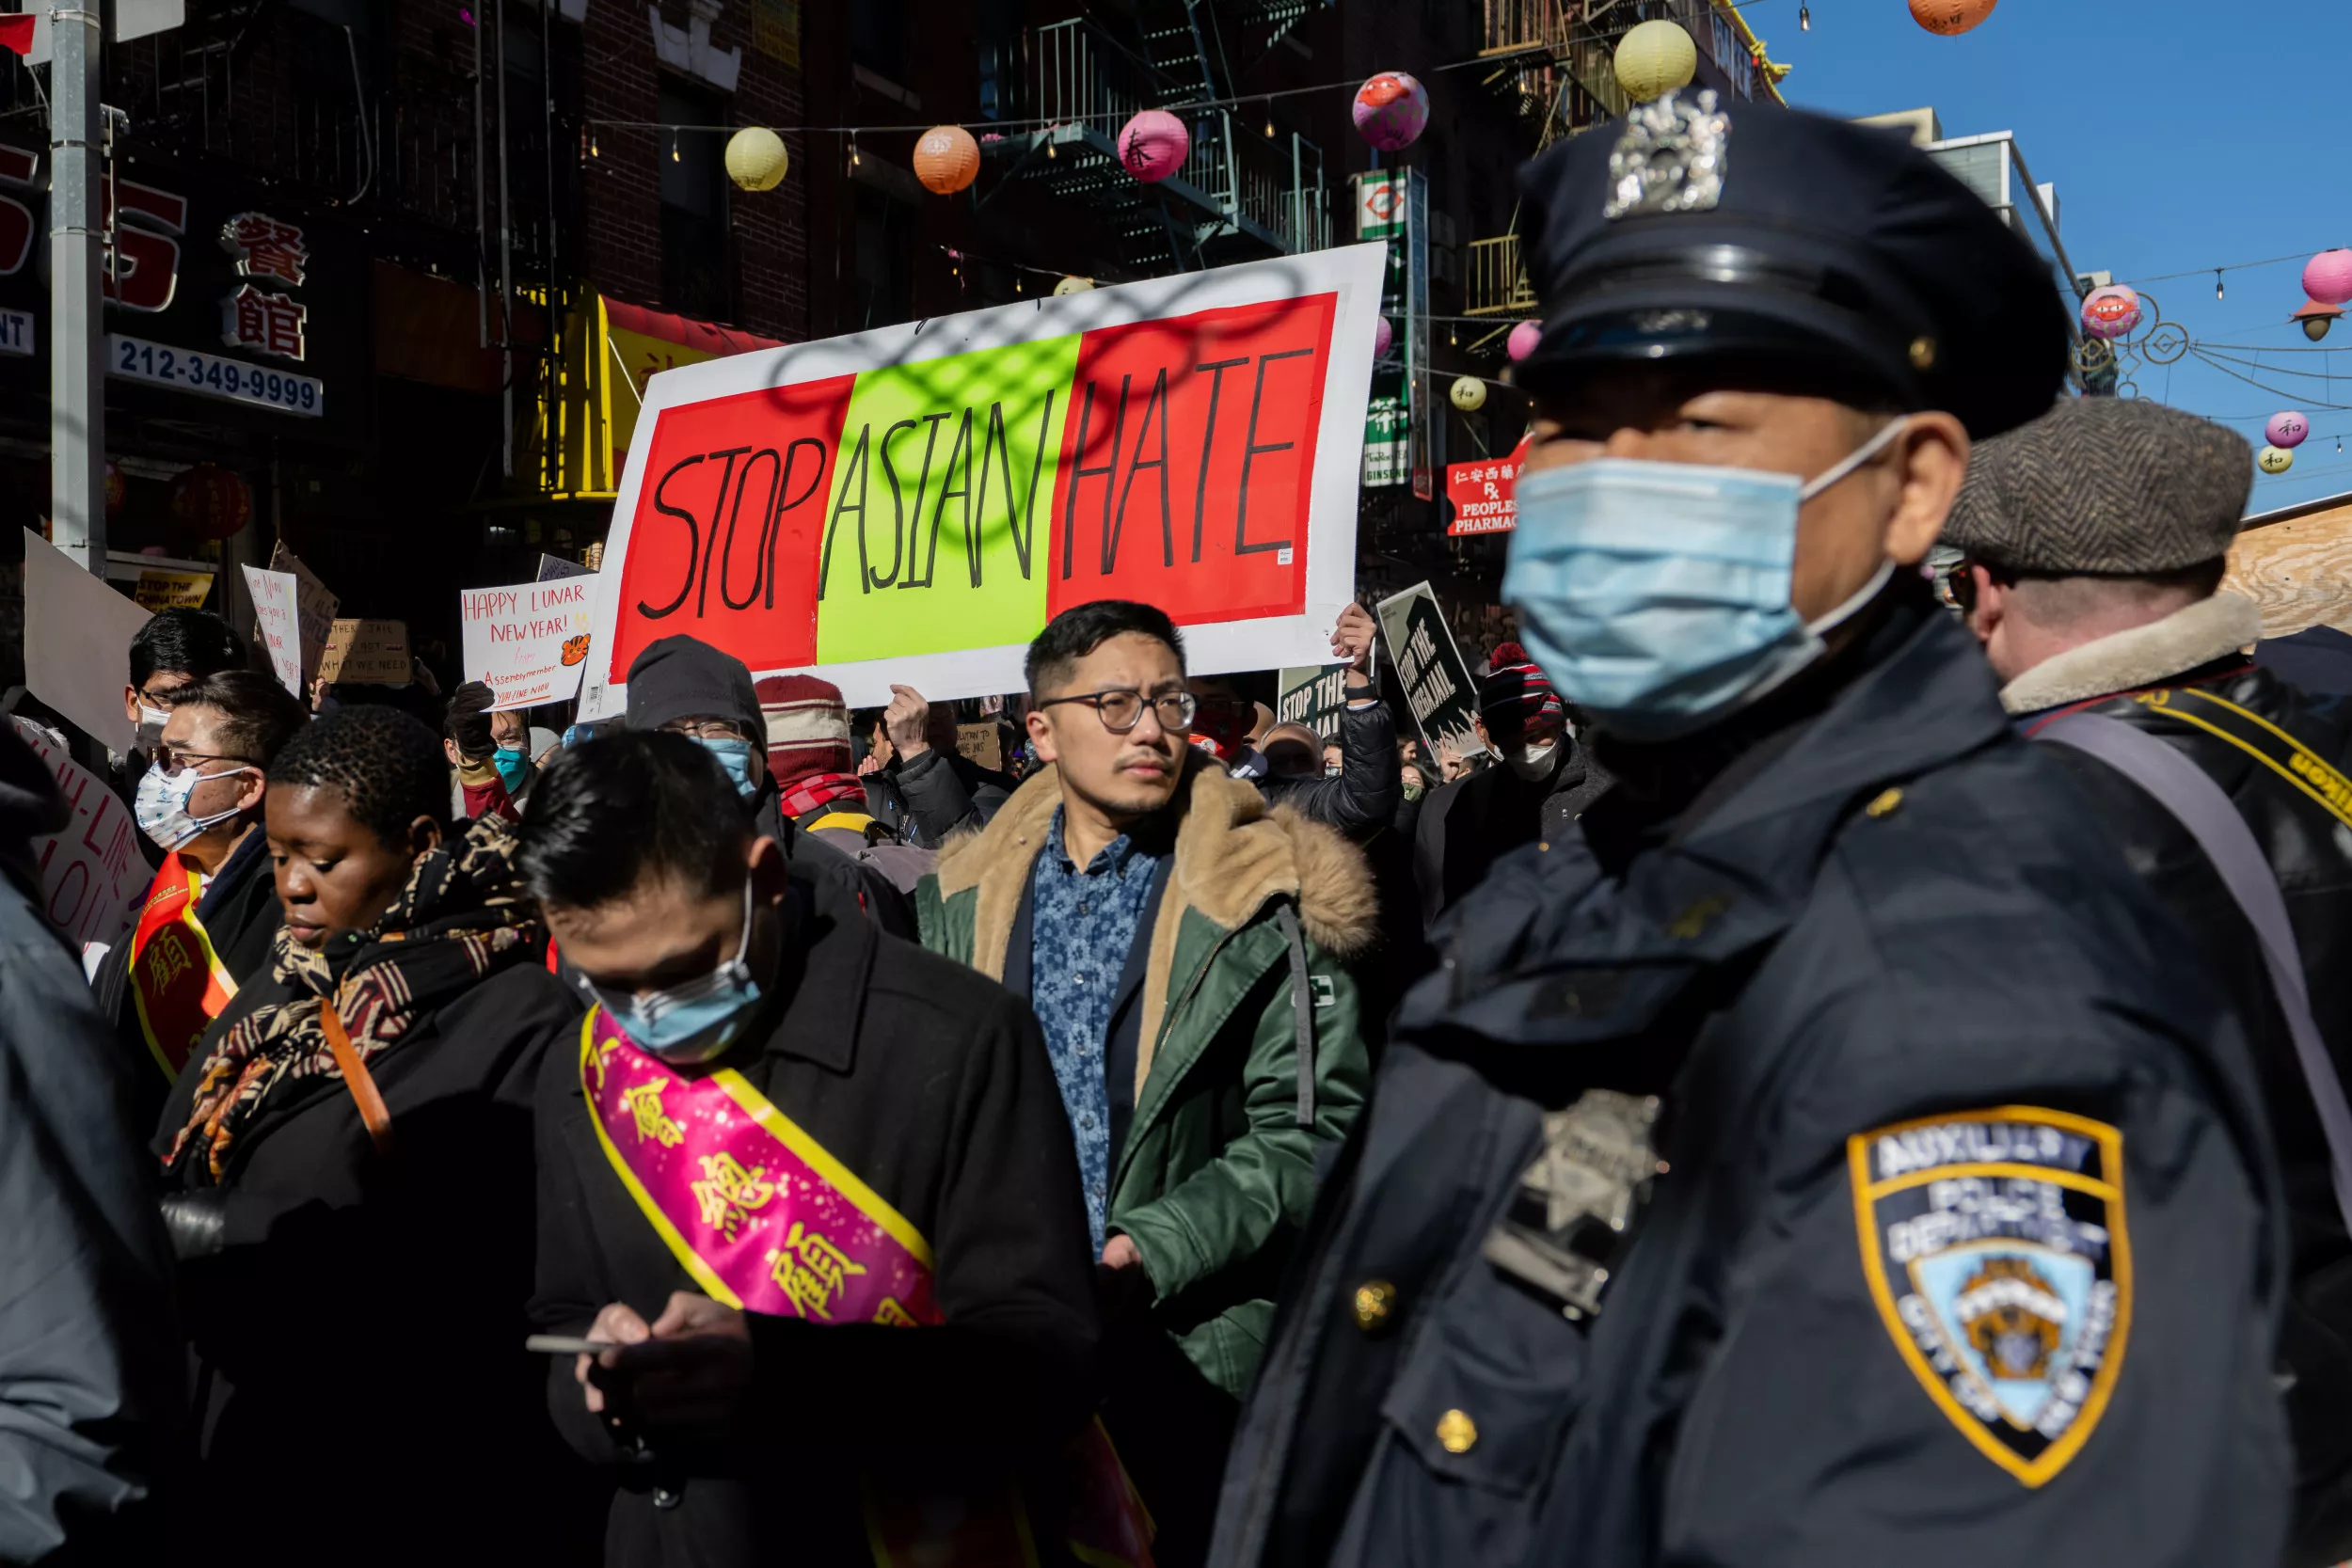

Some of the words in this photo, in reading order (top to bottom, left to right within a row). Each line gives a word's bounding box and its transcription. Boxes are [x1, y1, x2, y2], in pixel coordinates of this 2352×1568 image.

[235, 212, 309, 361] 餐館
[120, 341, 315, 409] 212-349-9999
[2278, 420, 2302, 437] 和
[2265, 452, 2283, 467] 和
[637, 437, 826, 619] STOP
[818, 388, 1056, 602] ASIAN
[1062, 348, 1313, 580] HATE
[138, 578, 169, 592] STOP
[171, 581, 193, 593] THE
[135, 593, 202, 605] CHINATOWN
[463, 592, 517, 621] HAPPY
[532, 584, 585, 611] LUNAR
[332, 624, 356, 634] THER
[491, 624, 527, 642] NEW
[530, 614, 567, 640] YEAR!
[357, 659, 374, 671] WE
[379, 659, 406, 671] NEED
[1399, 647, 1419, 692] STOP
[1410, 617, 1437, 670] THE
[485, 665, 556, 686] Assemblymember
[531, 683, 549, 694] NIOU
[1282, 686, 1312, 721] STOP
[1315, 669, 1347, 711] THE
